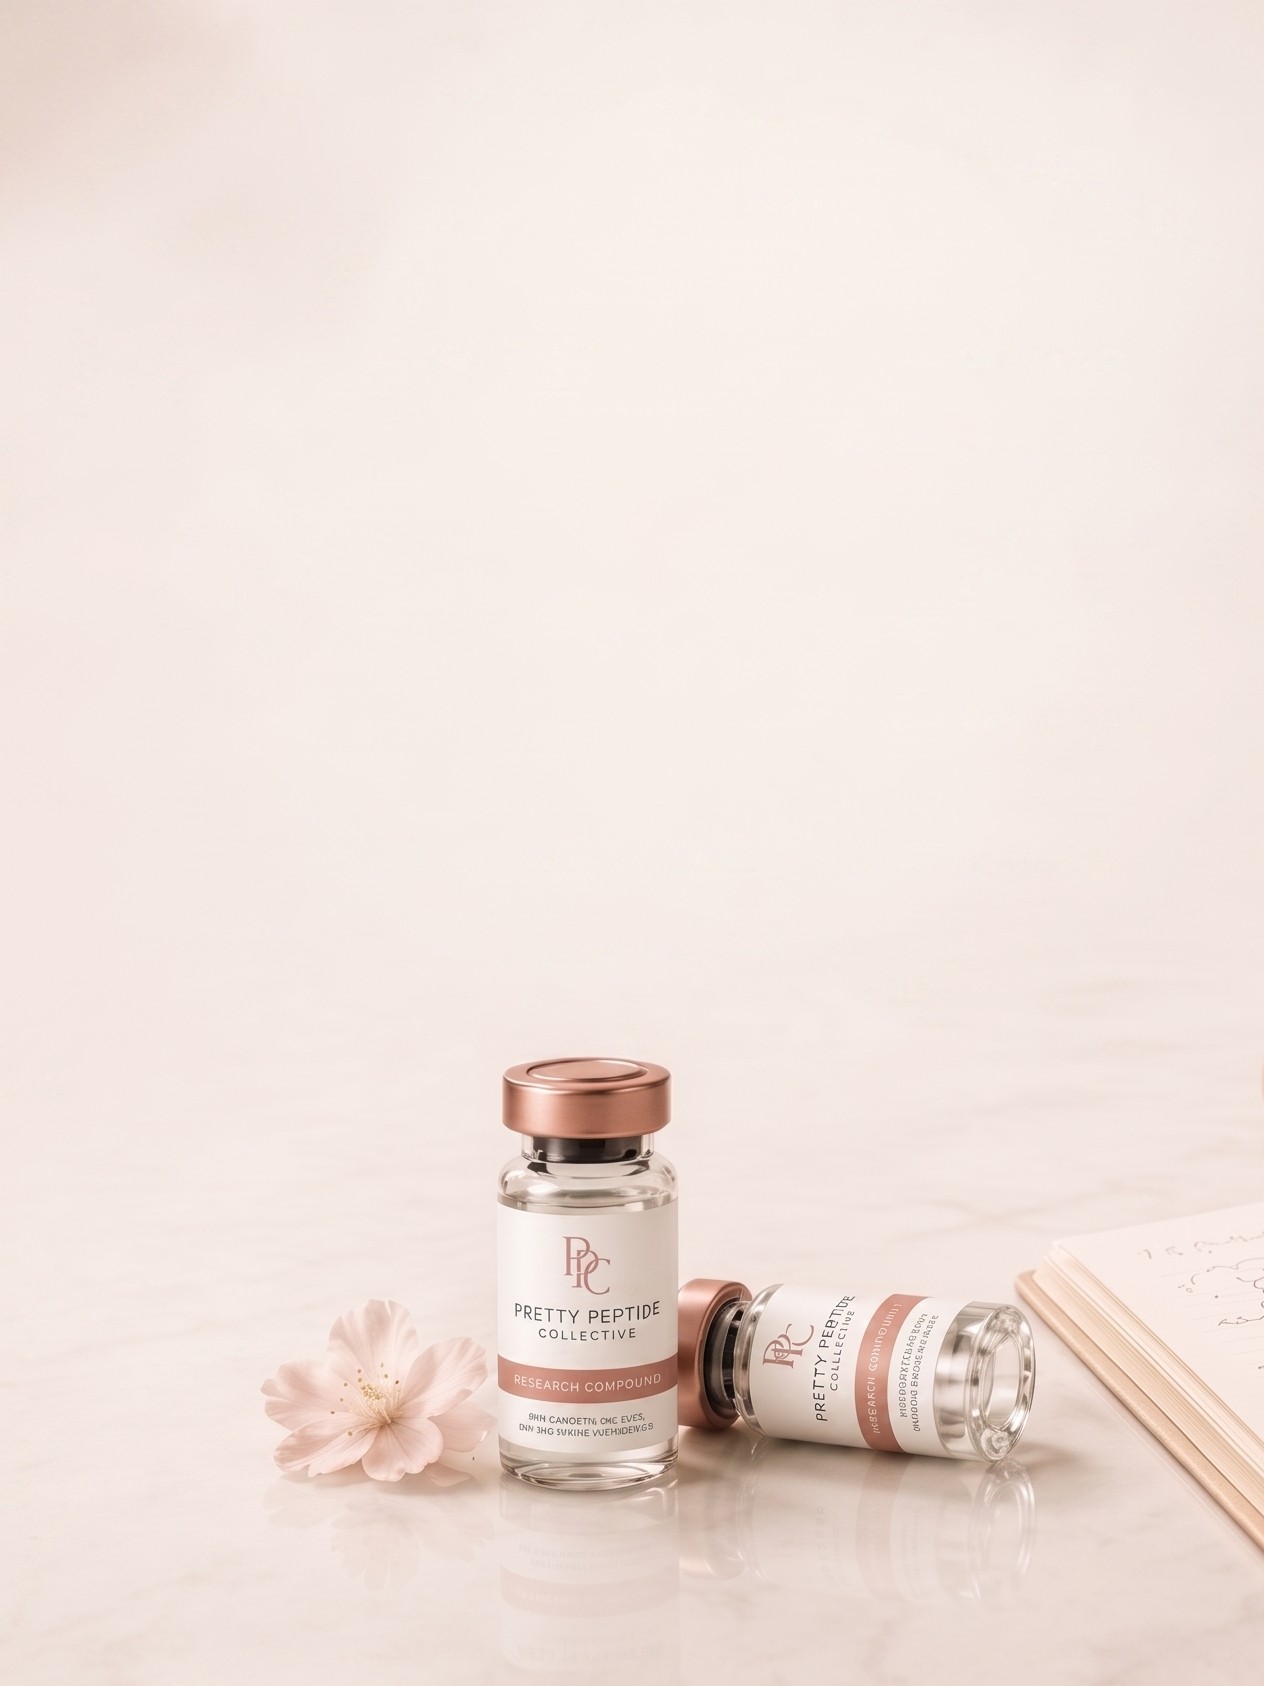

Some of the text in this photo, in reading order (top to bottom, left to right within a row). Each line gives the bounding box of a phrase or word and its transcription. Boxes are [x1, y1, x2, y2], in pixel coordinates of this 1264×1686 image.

[514, 1300, 661, 1324] PRETTY PEPTIDE
[538, 1327, 637, 1341] COLLECTIVE
[514, 1373, 661, 1392] RESEARCH COMPOUND
[812, 1354, 828, 1422] PRETTY
